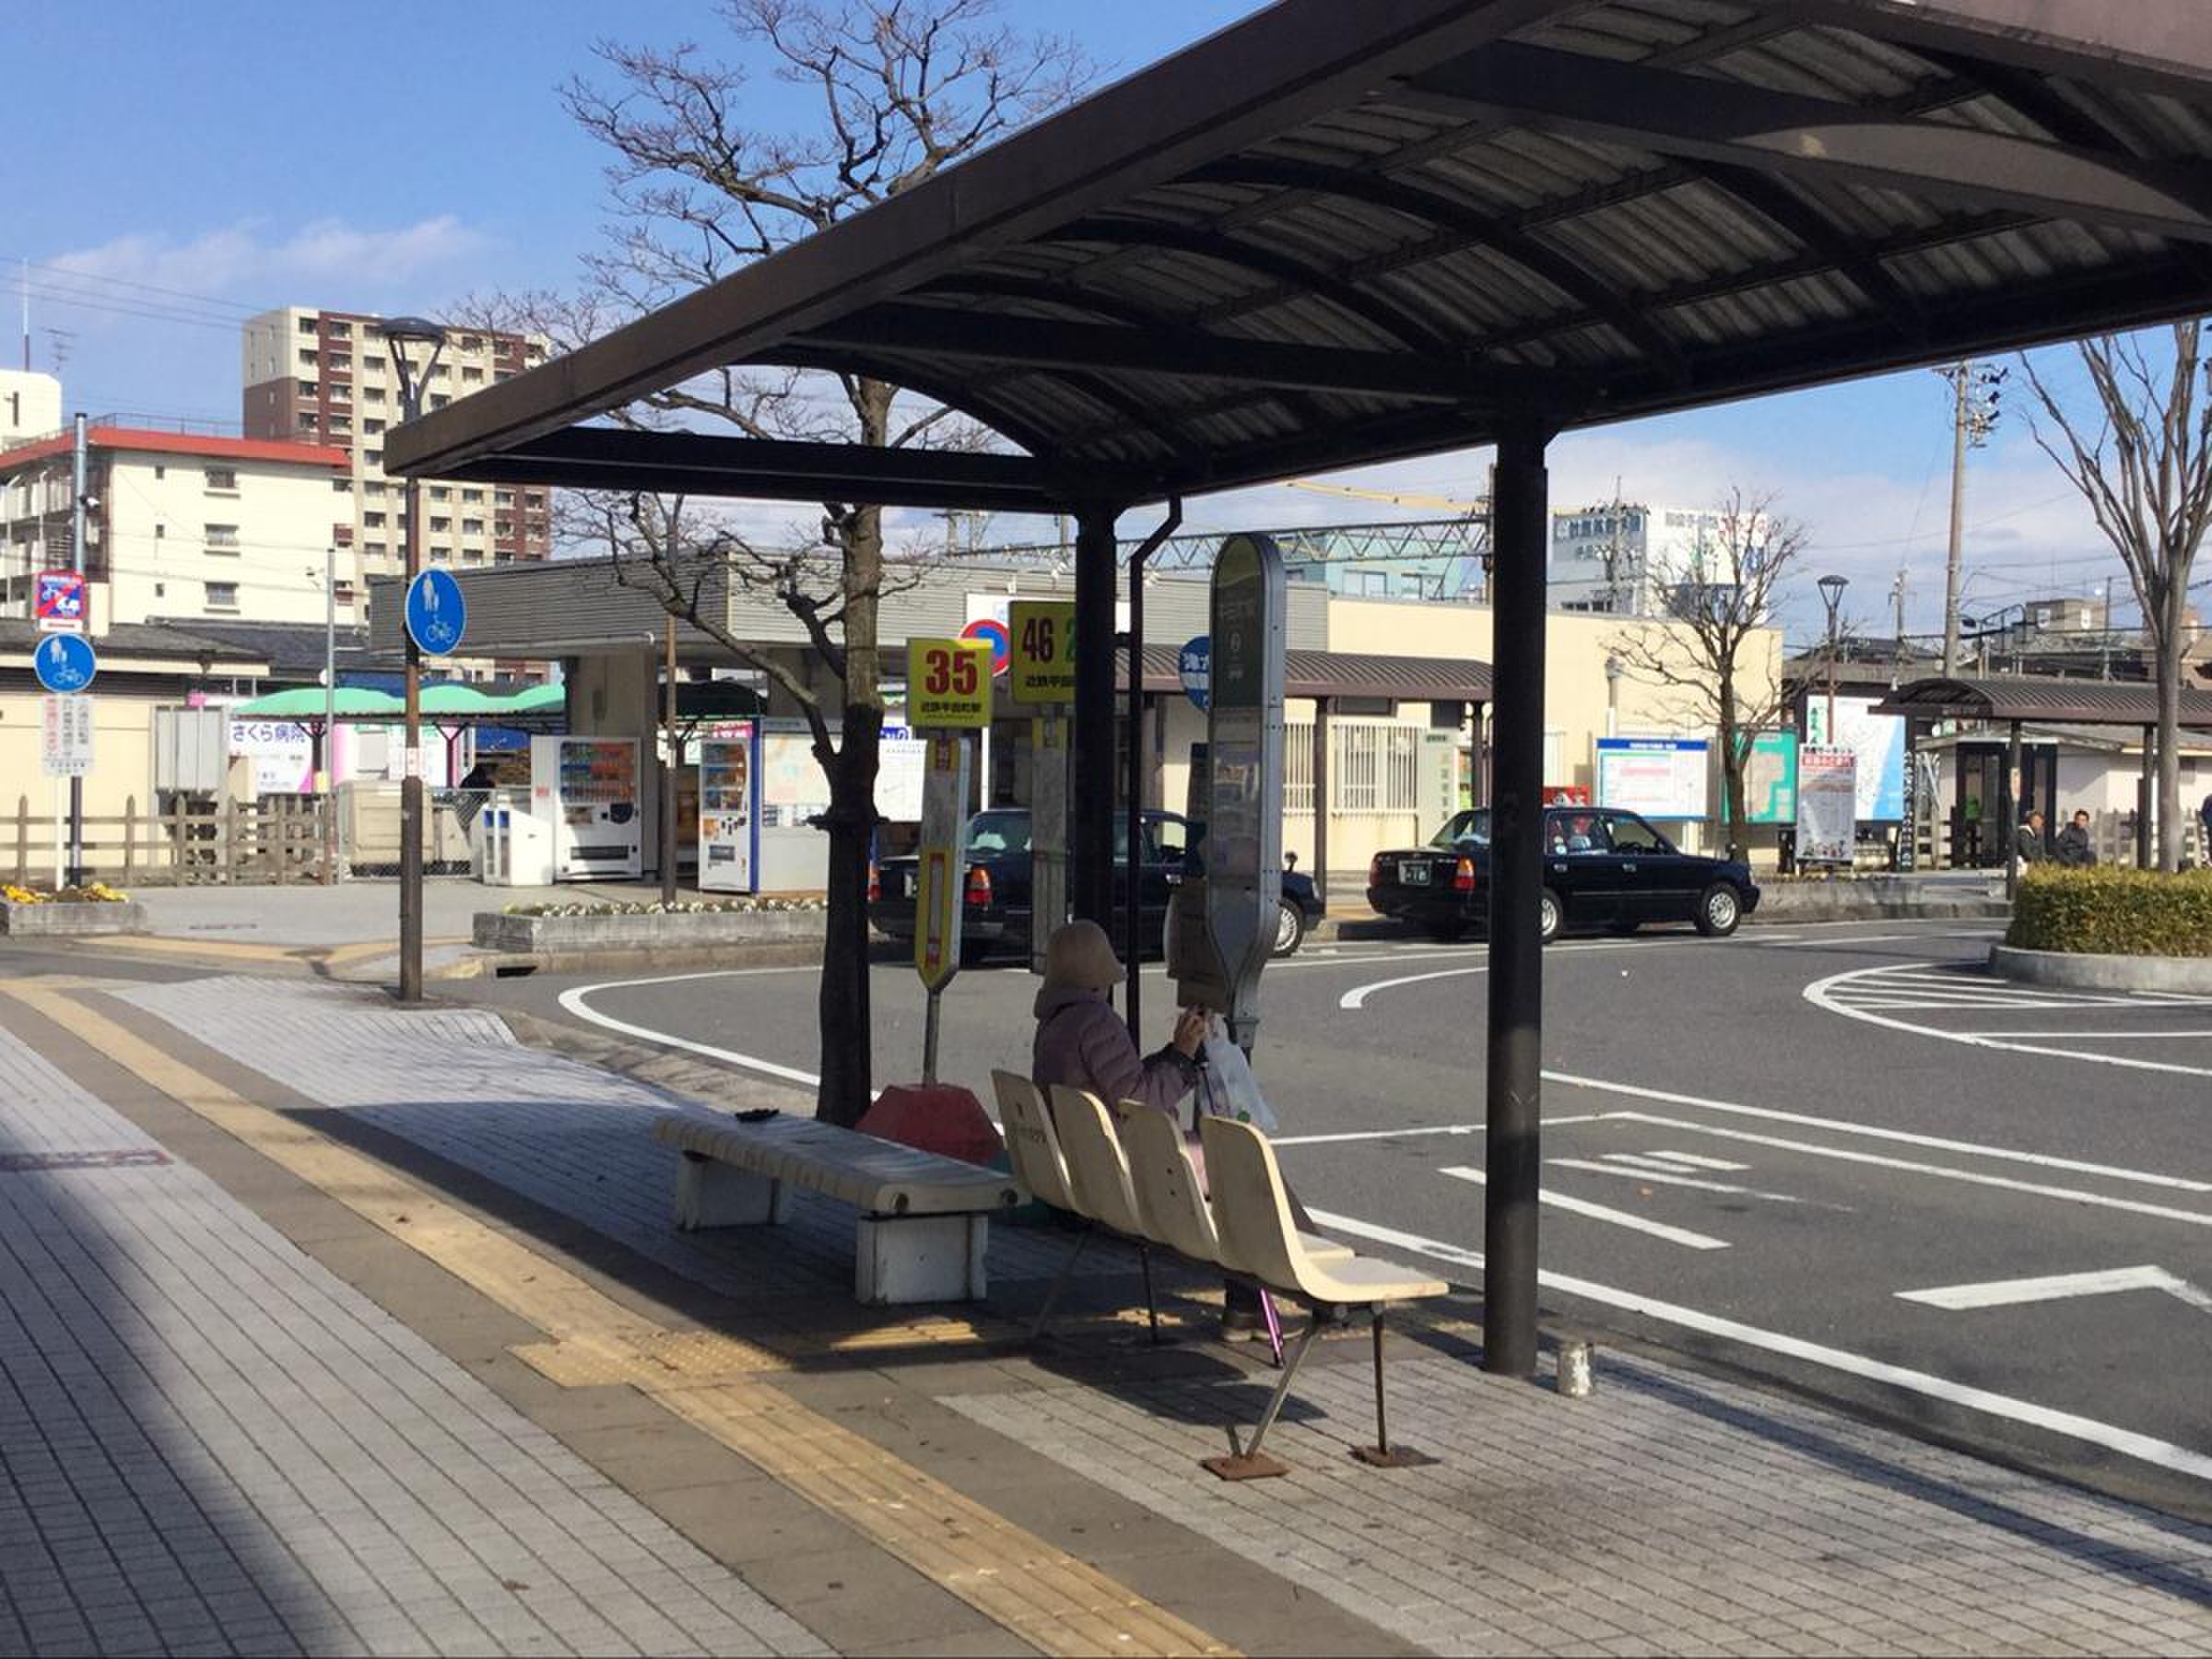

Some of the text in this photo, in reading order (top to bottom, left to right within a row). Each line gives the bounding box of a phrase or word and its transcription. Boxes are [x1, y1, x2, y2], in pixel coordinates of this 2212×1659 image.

[1022, 617, 1054, 663] 46
[925, 649, 977, 696] 35
[233, 724, 306, 743] さくら病院
